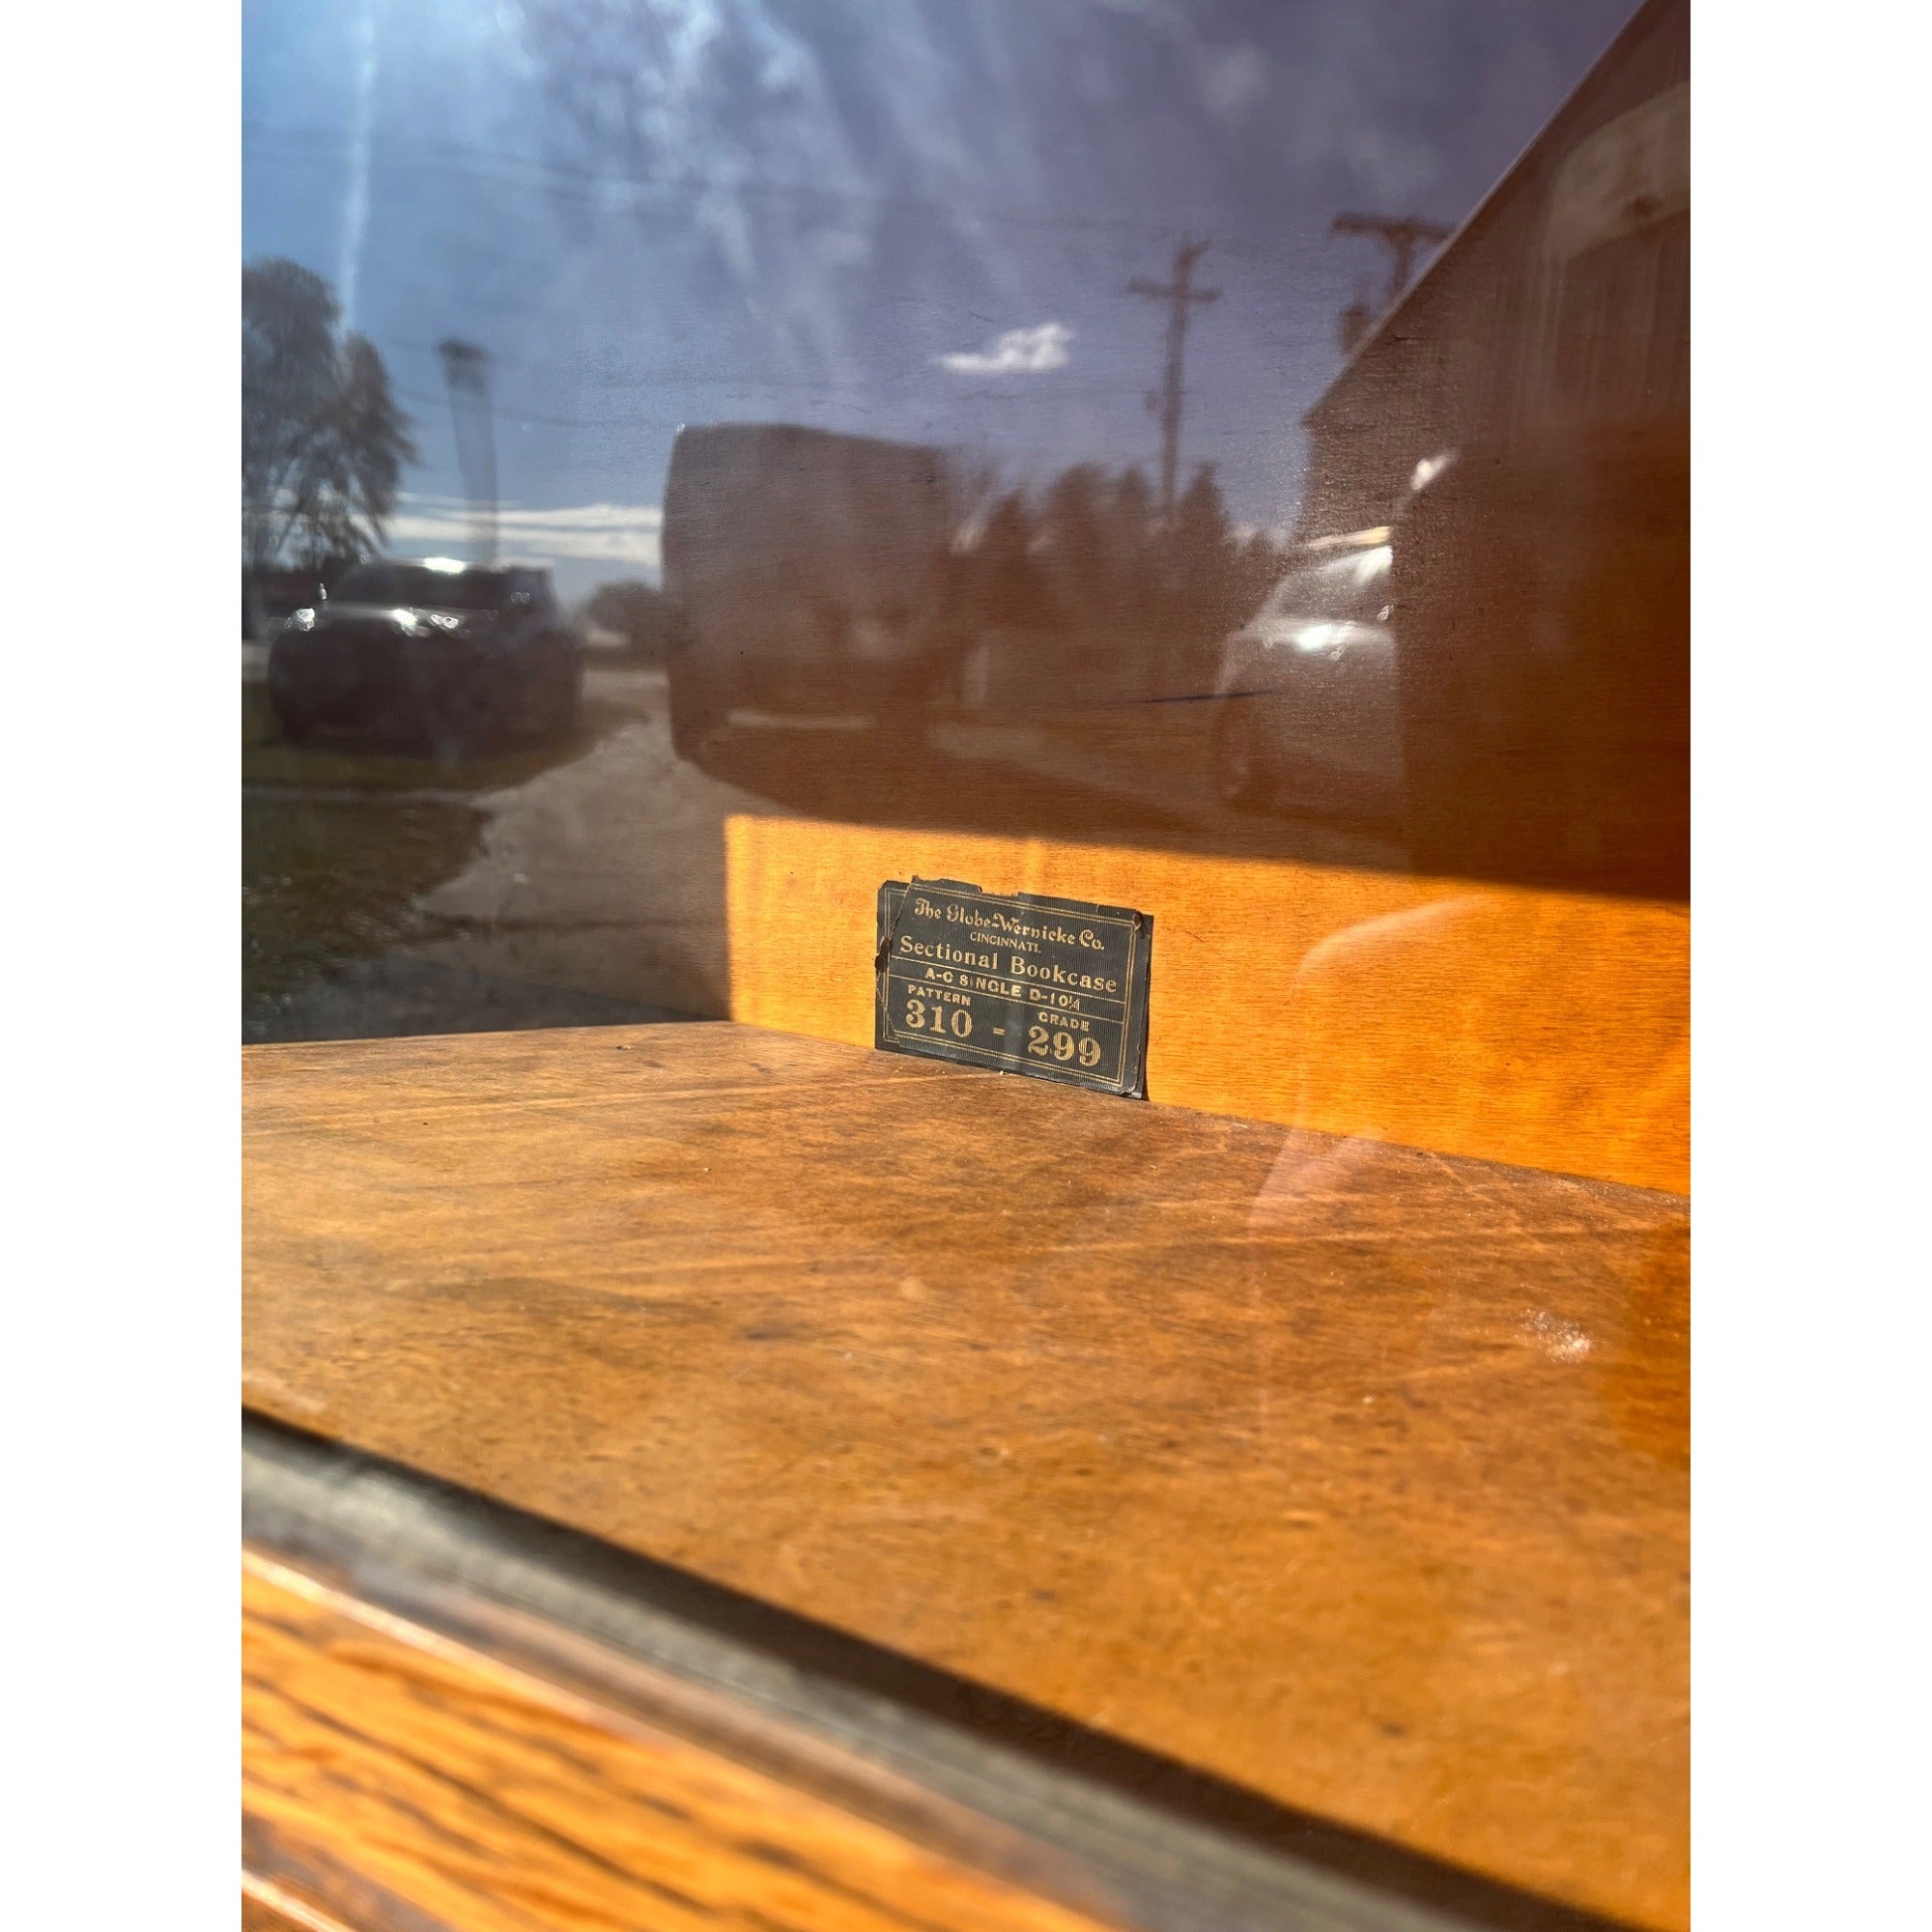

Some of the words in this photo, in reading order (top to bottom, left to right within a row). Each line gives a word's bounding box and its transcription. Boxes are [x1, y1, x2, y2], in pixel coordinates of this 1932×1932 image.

[915, 897, 941, 920] The
[946, 903, 1076, 947] Globe-Wernicke
[1079, 929, 1105, 951] Co.
[899, 935, 999, 970] Sectional
[1009, 955, 1118, 993] Bookcase
[924, 968, 954, 982] A-C
[907, 984, 972, 1007] PATTERN
[905, 999, 974, 1038] 310
[1027, 1025, 1102, 1067] 299
[1037, 1011, 1091, 1032] GRADE
